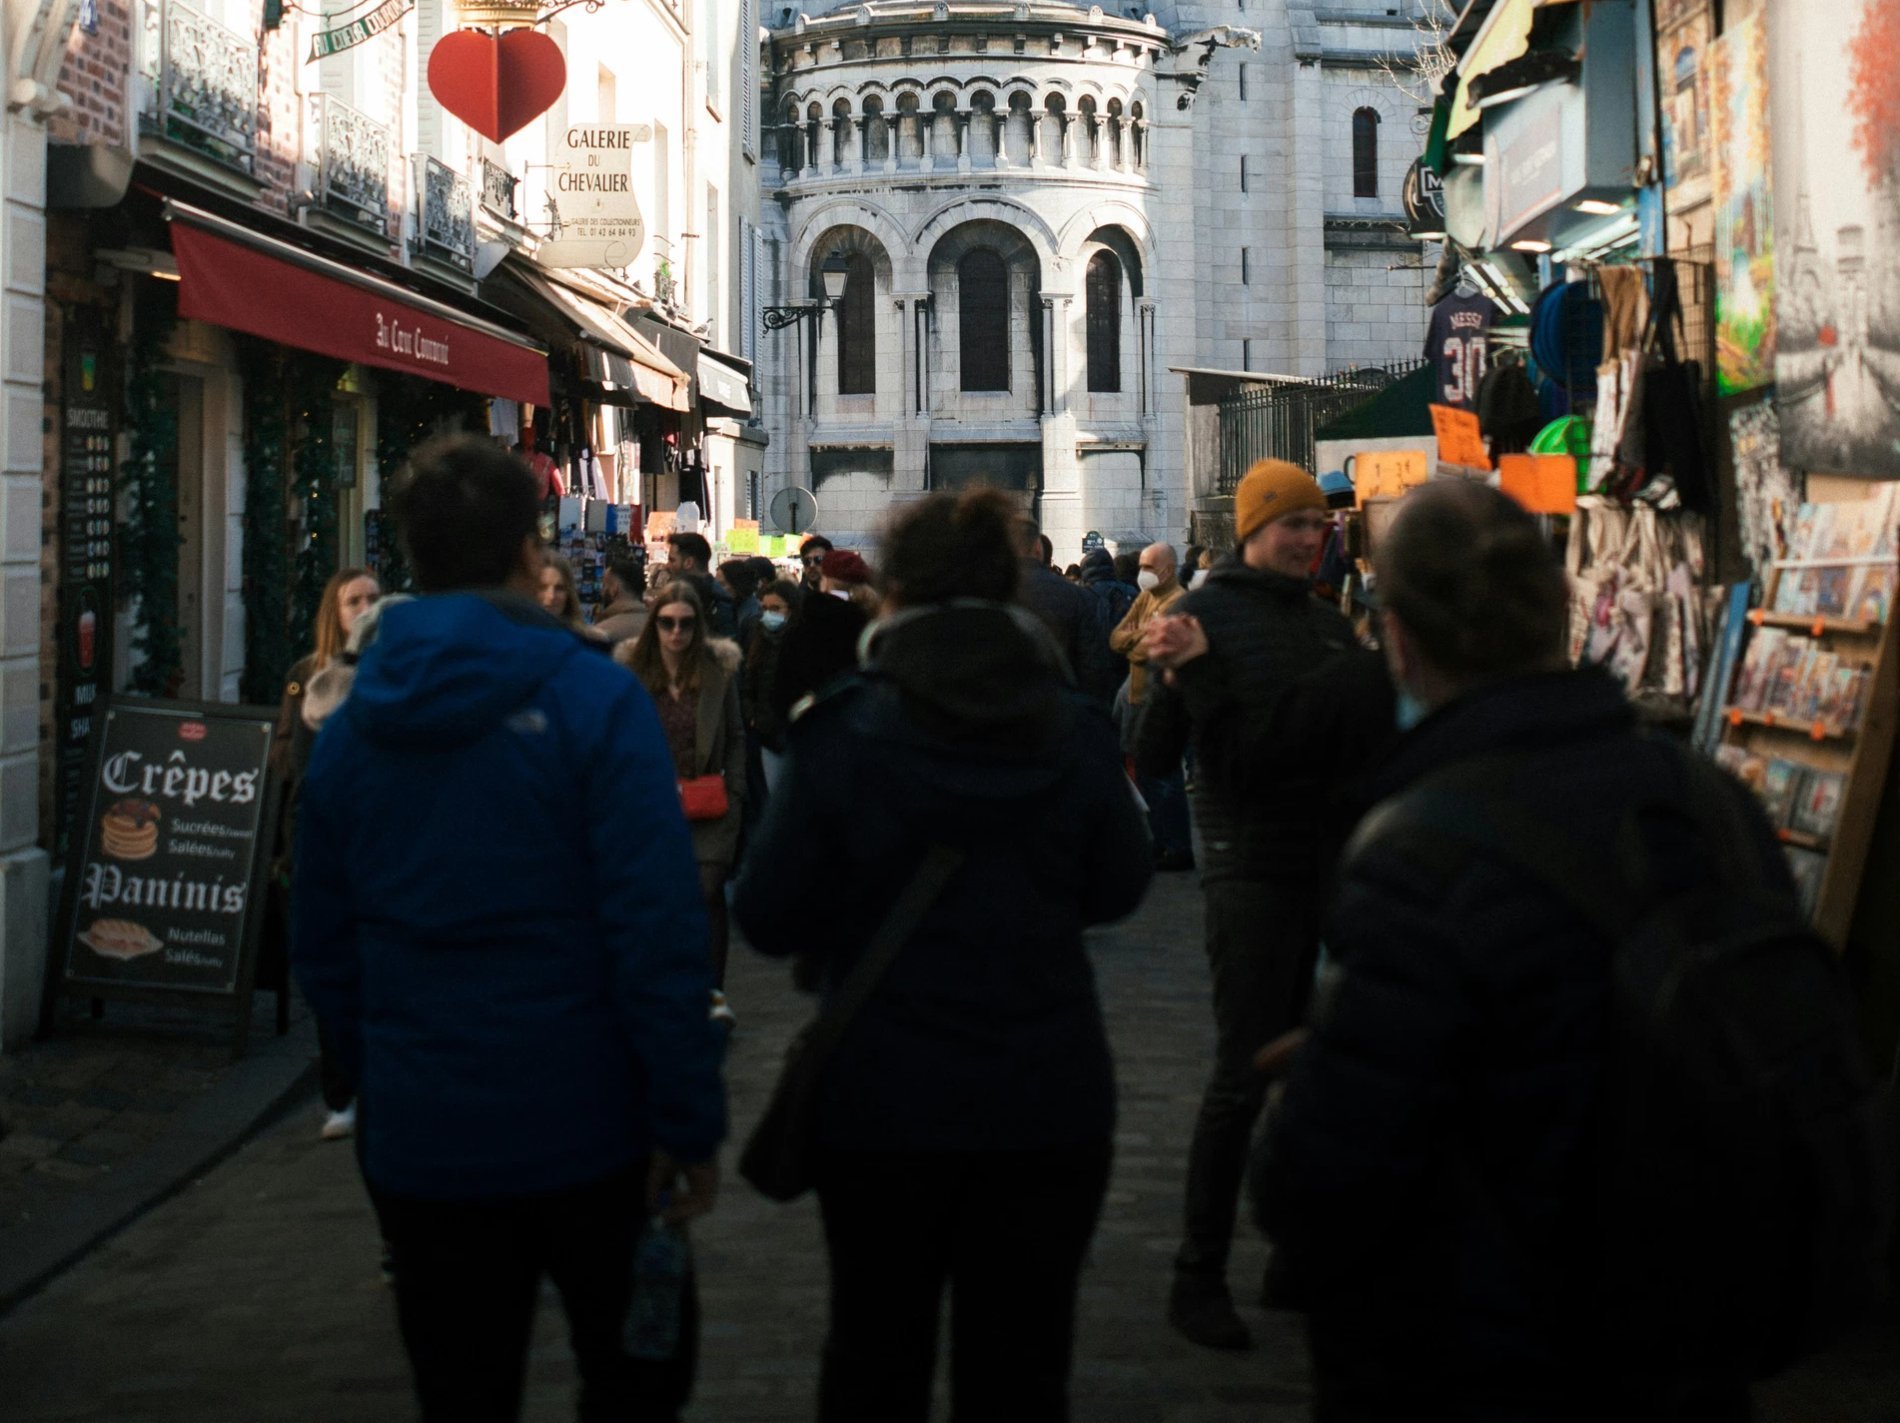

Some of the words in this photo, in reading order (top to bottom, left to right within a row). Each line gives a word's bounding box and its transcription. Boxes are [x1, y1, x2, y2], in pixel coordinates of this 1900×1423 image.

[567, 129, 630, 149] GALERIE
[588, 154, 600, 167] DU
[559, 172, 628, 192] CHEVALIER
[1444, 337, 1487, 402] 30
[102, 749, 260, 807] Crêpes
[81, 862, 247, 914] Paninis
